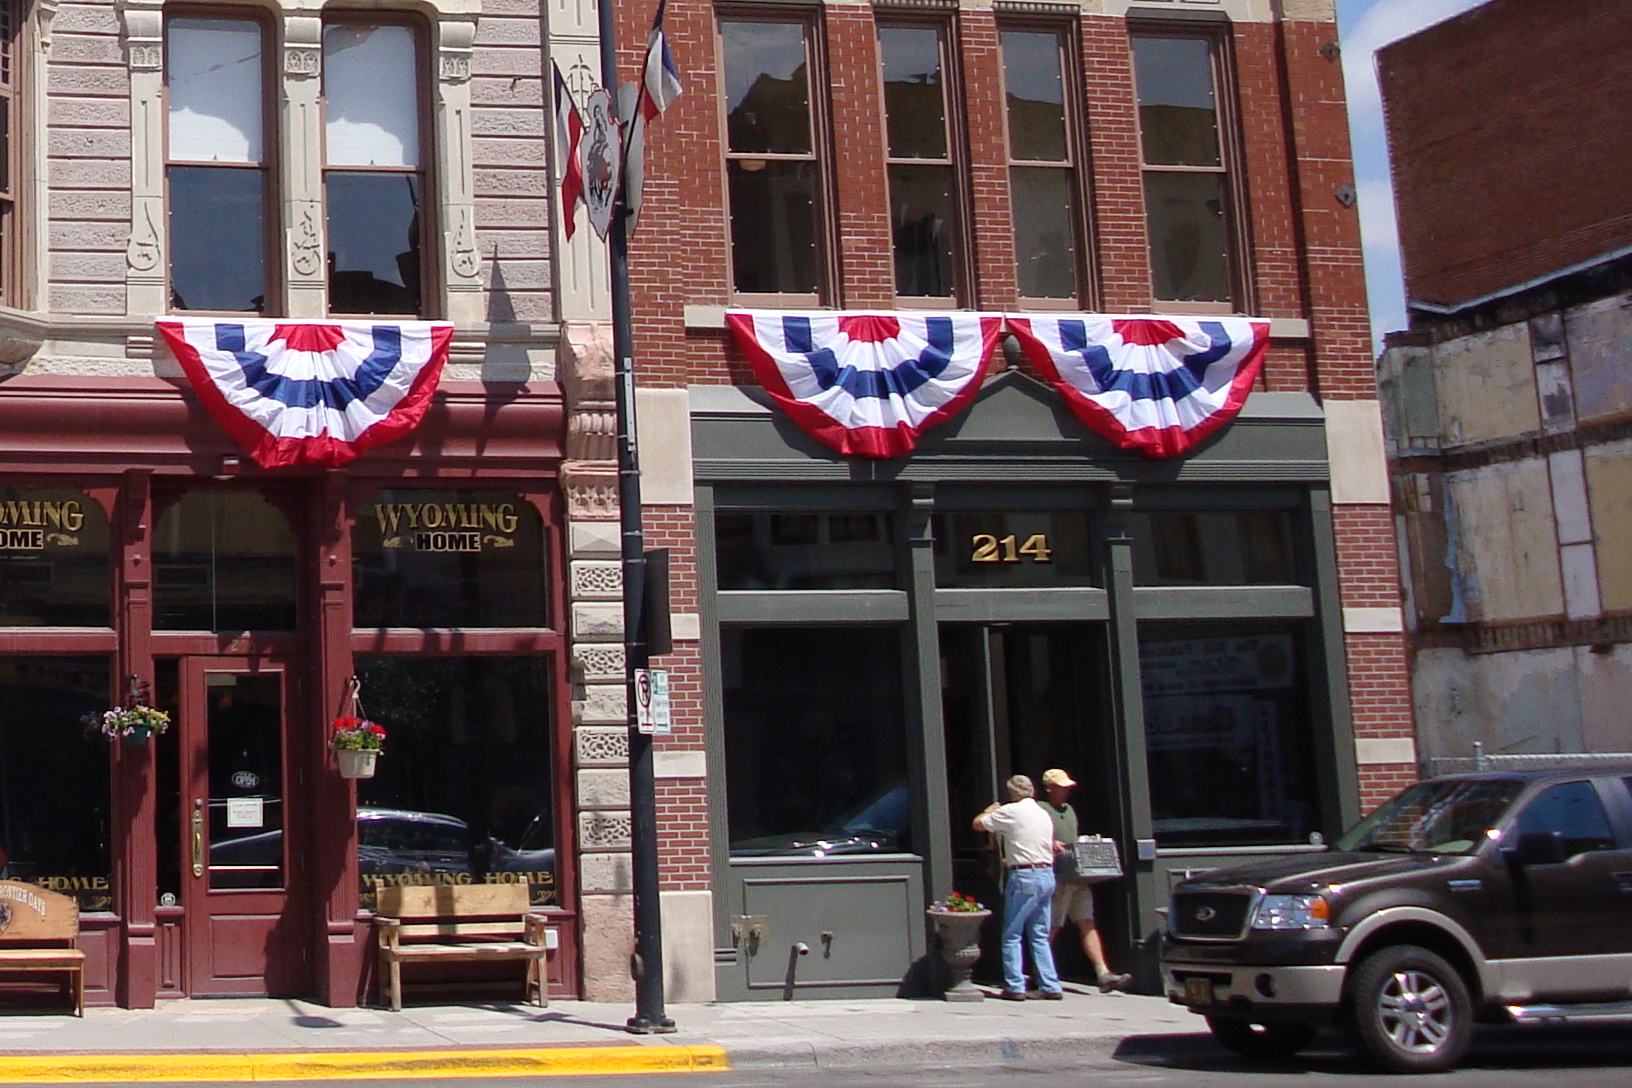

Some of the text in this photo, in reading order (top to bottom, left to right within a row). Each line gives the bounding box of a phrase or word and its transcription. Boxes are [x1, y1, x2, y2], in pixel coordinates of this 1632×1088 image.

[374, 503, 518, 534] WYOMING
[415, 531, 482, 551] HOME
[971, 534, 1052, 562] 214
[35, 876, 109, 890] HOME
[28, 891, 46, 916] DAYS
